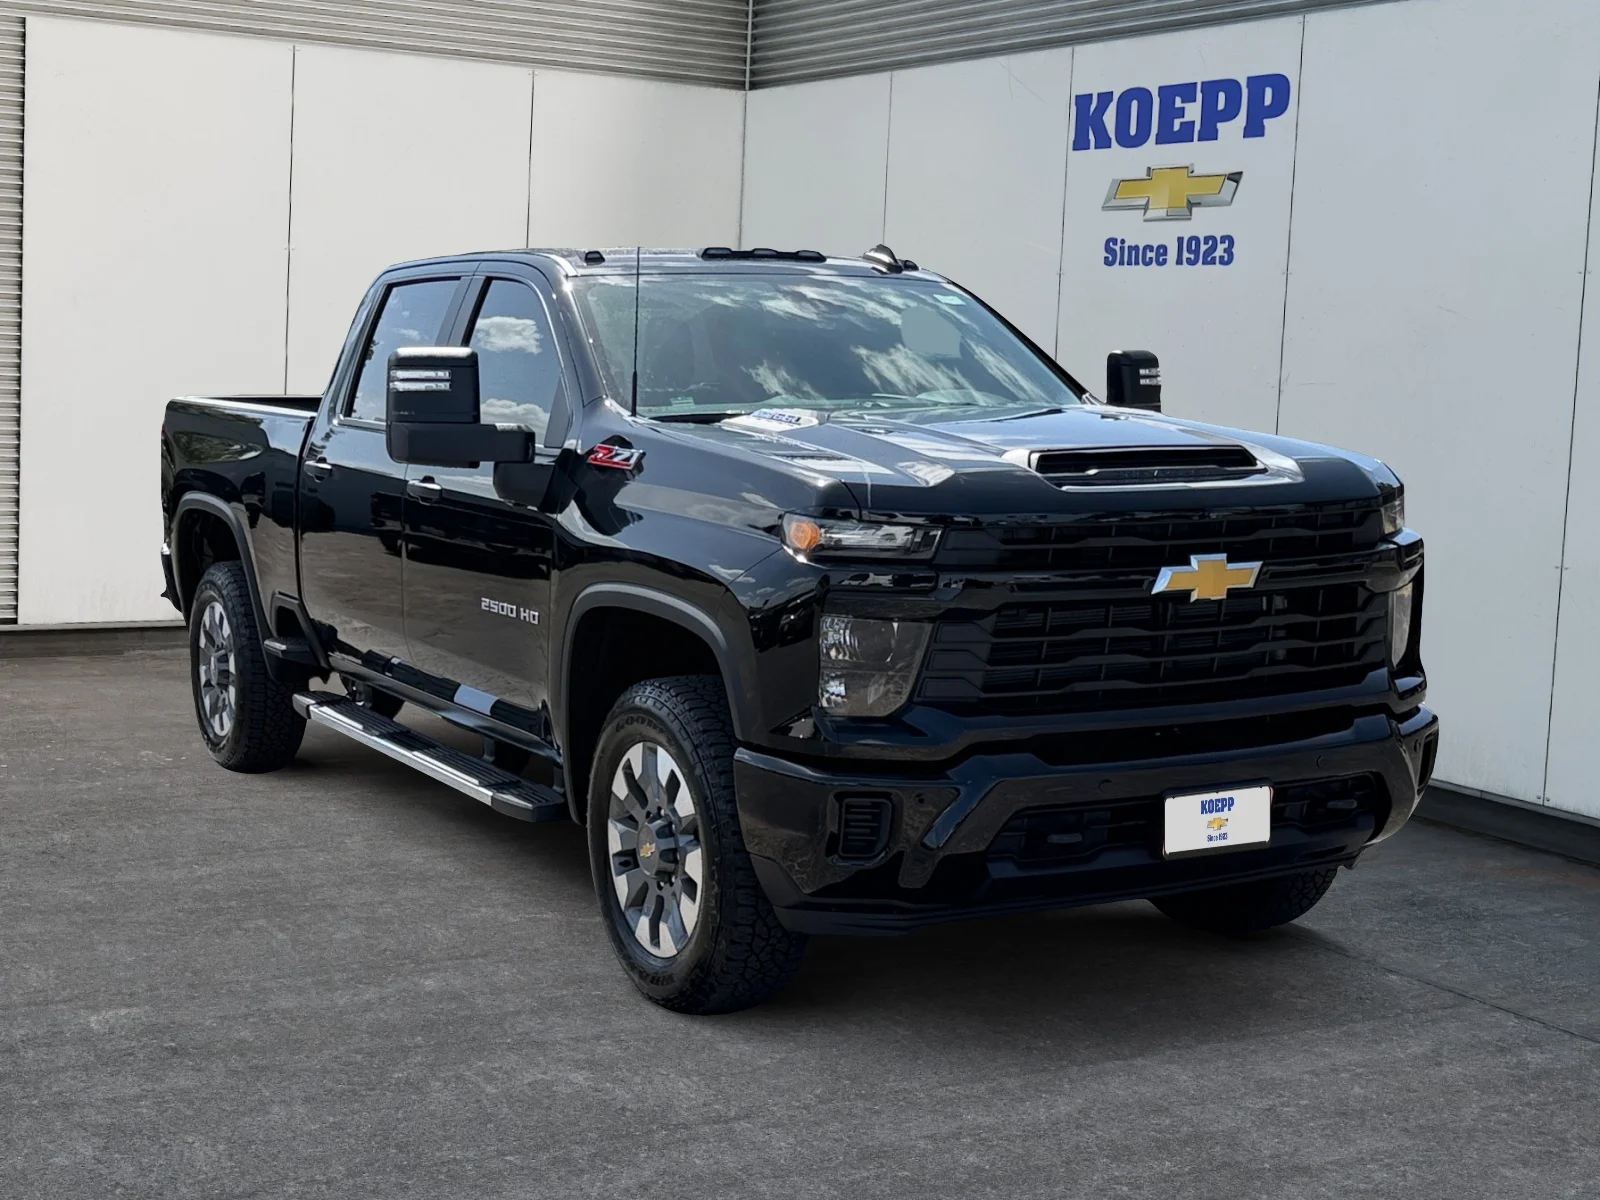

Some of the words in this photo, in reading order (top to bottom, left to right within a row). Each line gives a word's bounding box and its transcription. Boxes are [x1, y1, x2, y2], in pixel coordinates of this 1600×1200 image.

[1072, 73, 1291, 151] KOEPP
[1103, 237, 1168, 267] Since
[1175, 235, 1235, 266] 1923
[587, 443, 643, 470] Z71
[481, 597, 517, 618] 2500
[520, 607, 539, 625] HD
[1200, 797, 1235, 815] KOEPP
